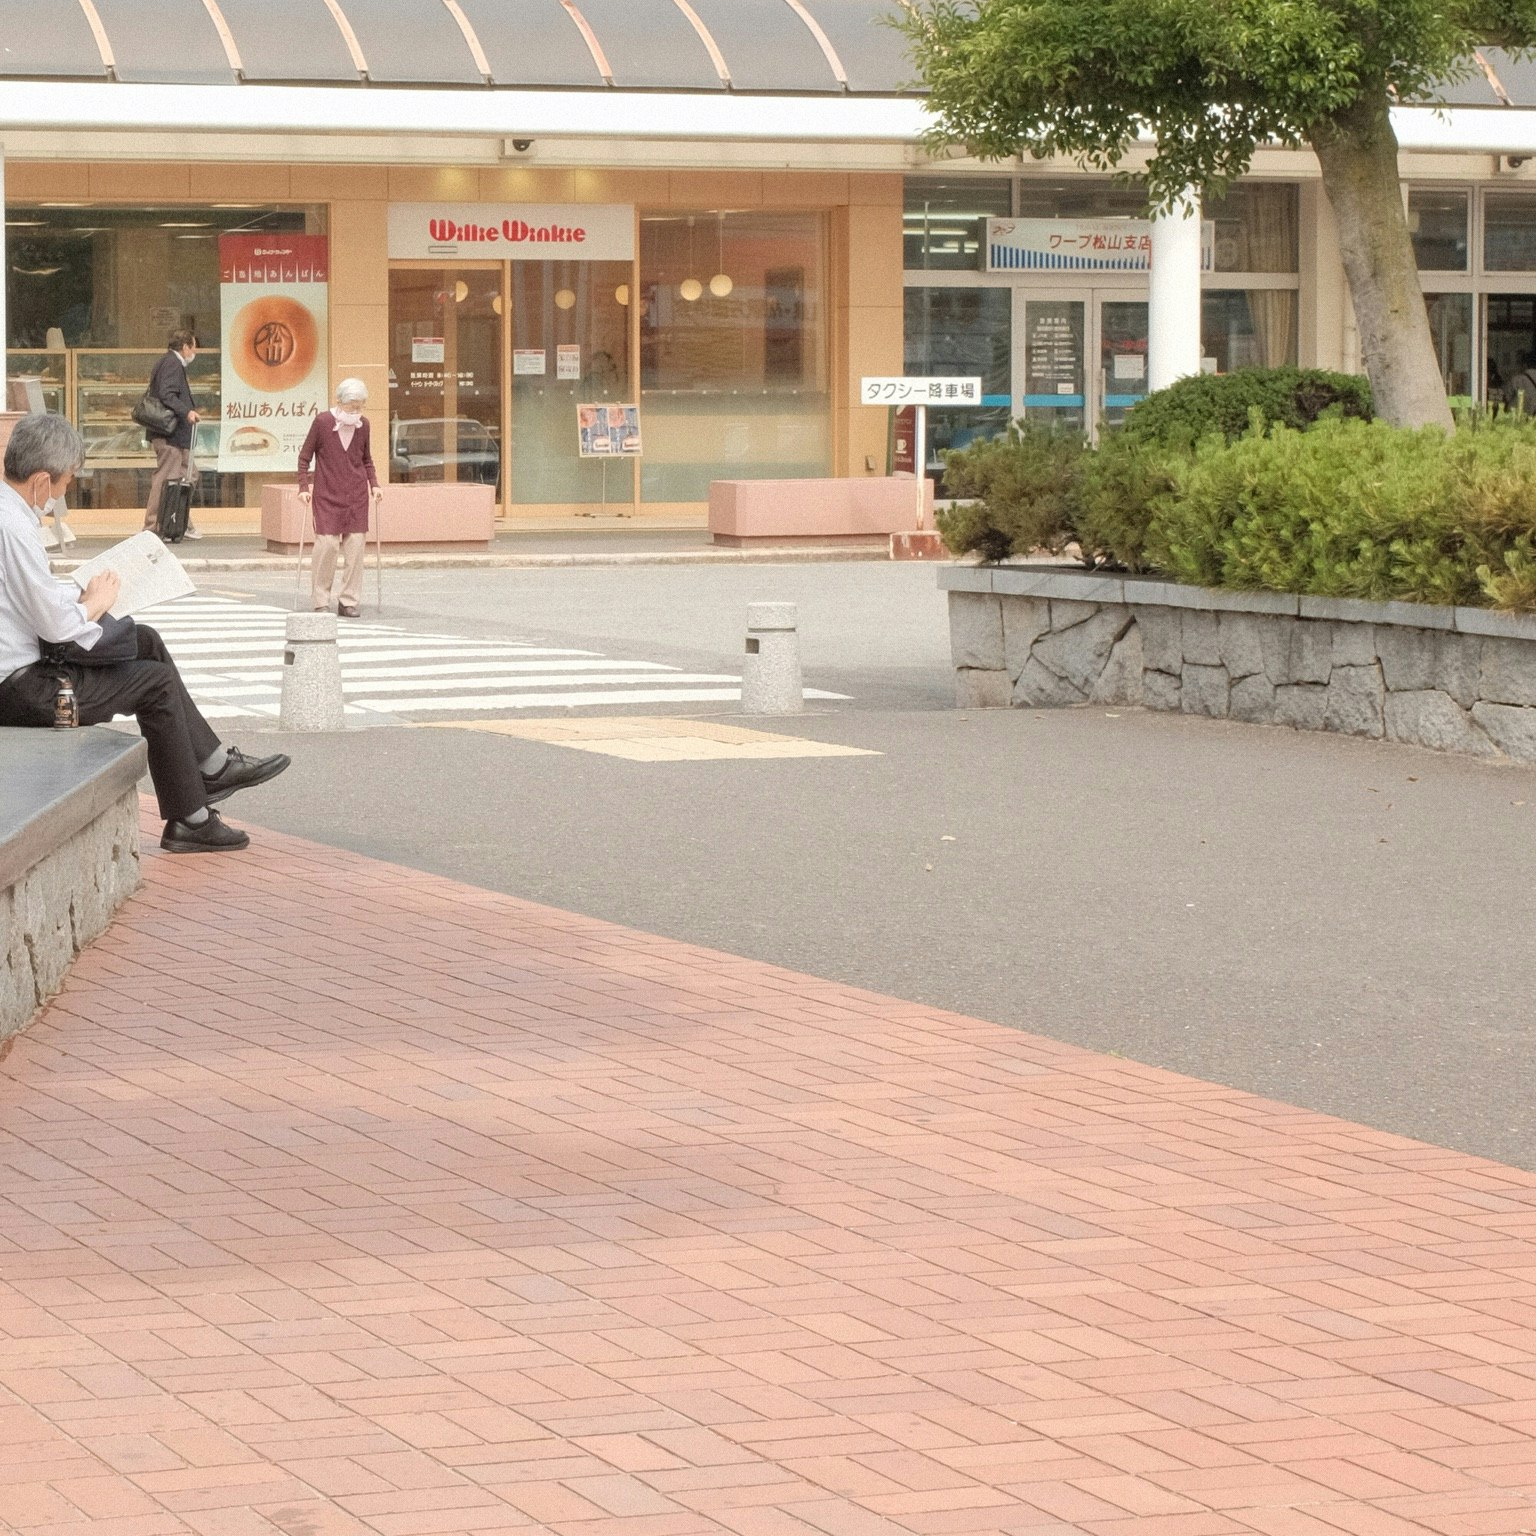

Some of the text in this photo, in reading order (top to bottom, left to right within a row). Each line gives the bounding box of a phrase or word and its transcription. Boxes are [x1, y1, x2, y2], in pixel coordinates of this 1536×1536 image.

[429, 218, 586, 243] Willie Winkie
[867, 382, 975, 399] タクシー降車場
